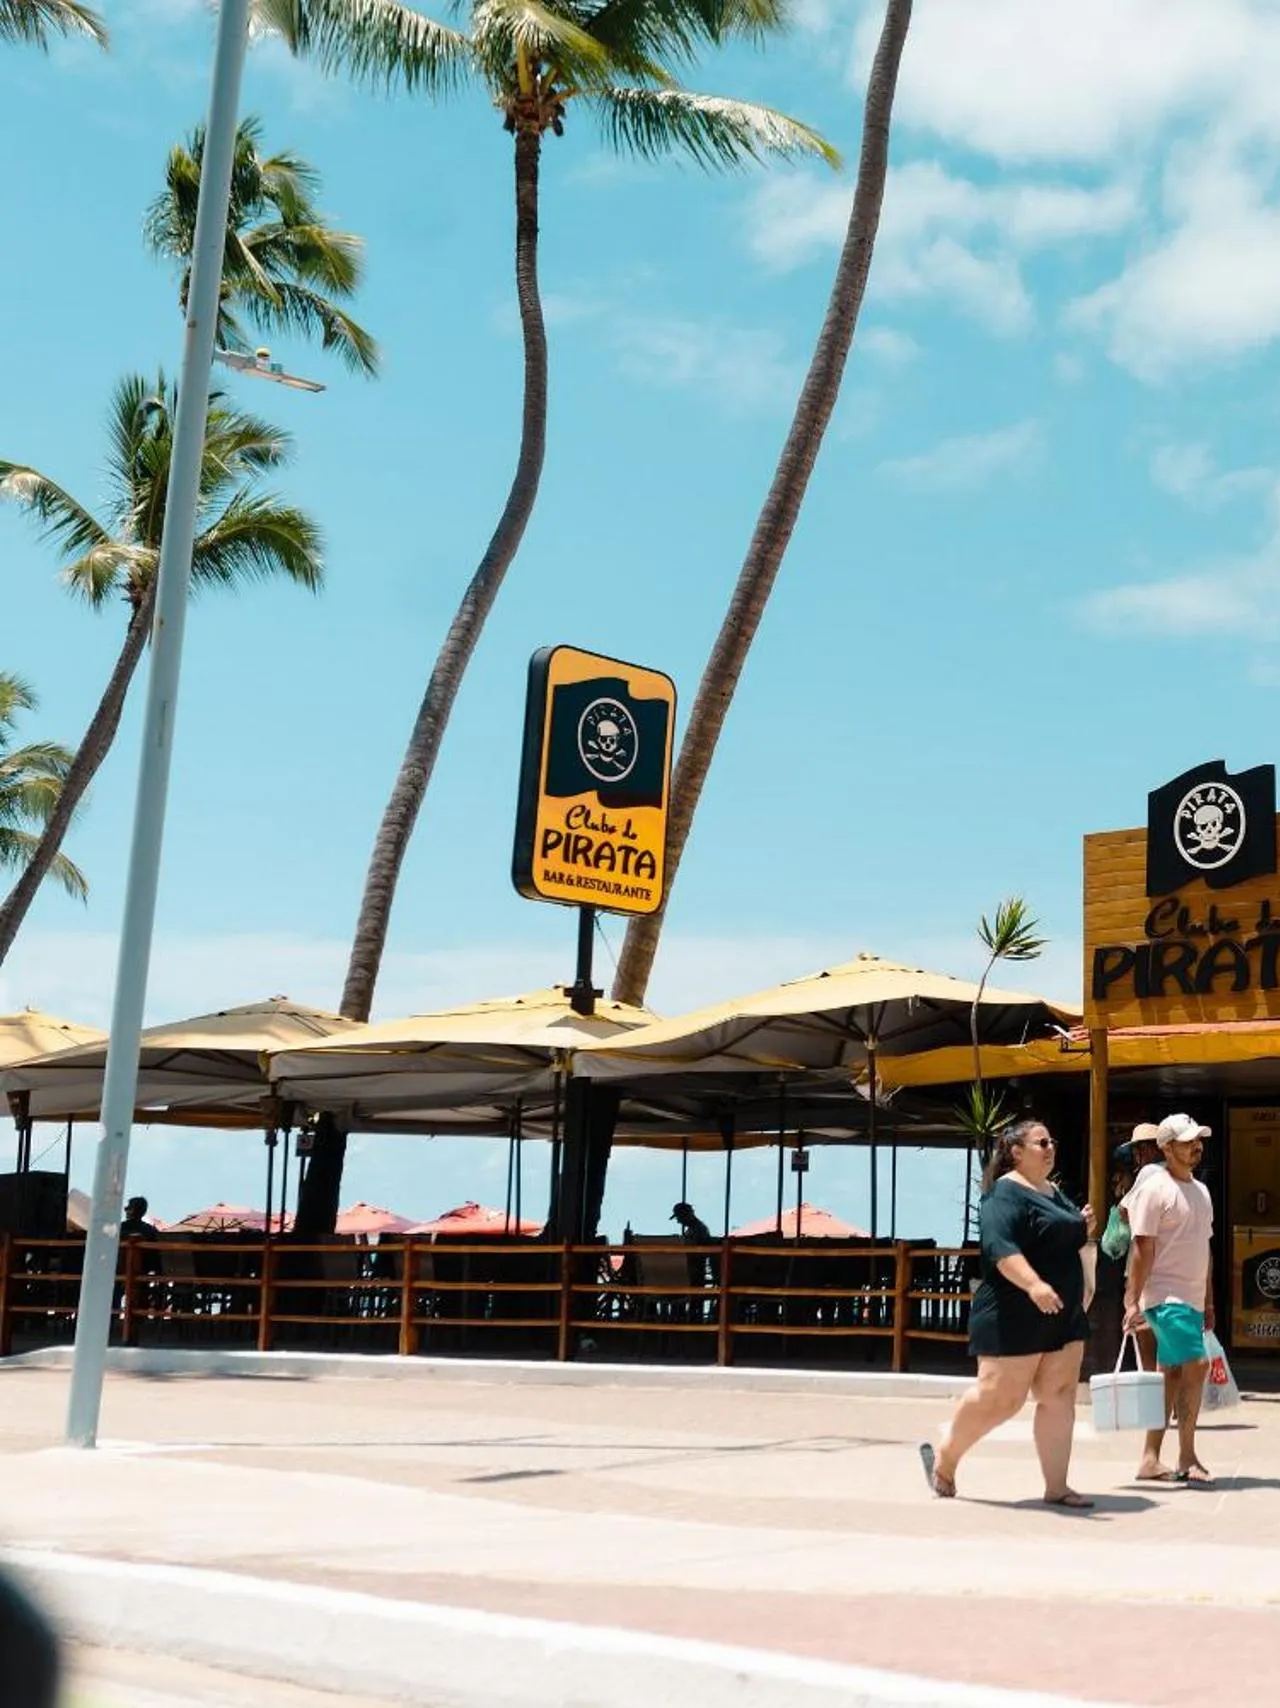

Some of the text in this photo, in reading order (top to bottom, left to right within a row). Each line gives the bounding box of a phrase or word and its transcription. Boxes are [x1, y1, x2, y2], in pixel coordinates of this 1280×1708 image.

[1181, 787, 1238, 819] PIRATA
[541, 828, 656, 880] PIRATA
[576, 876, 653, 901] RESTAURANTE
